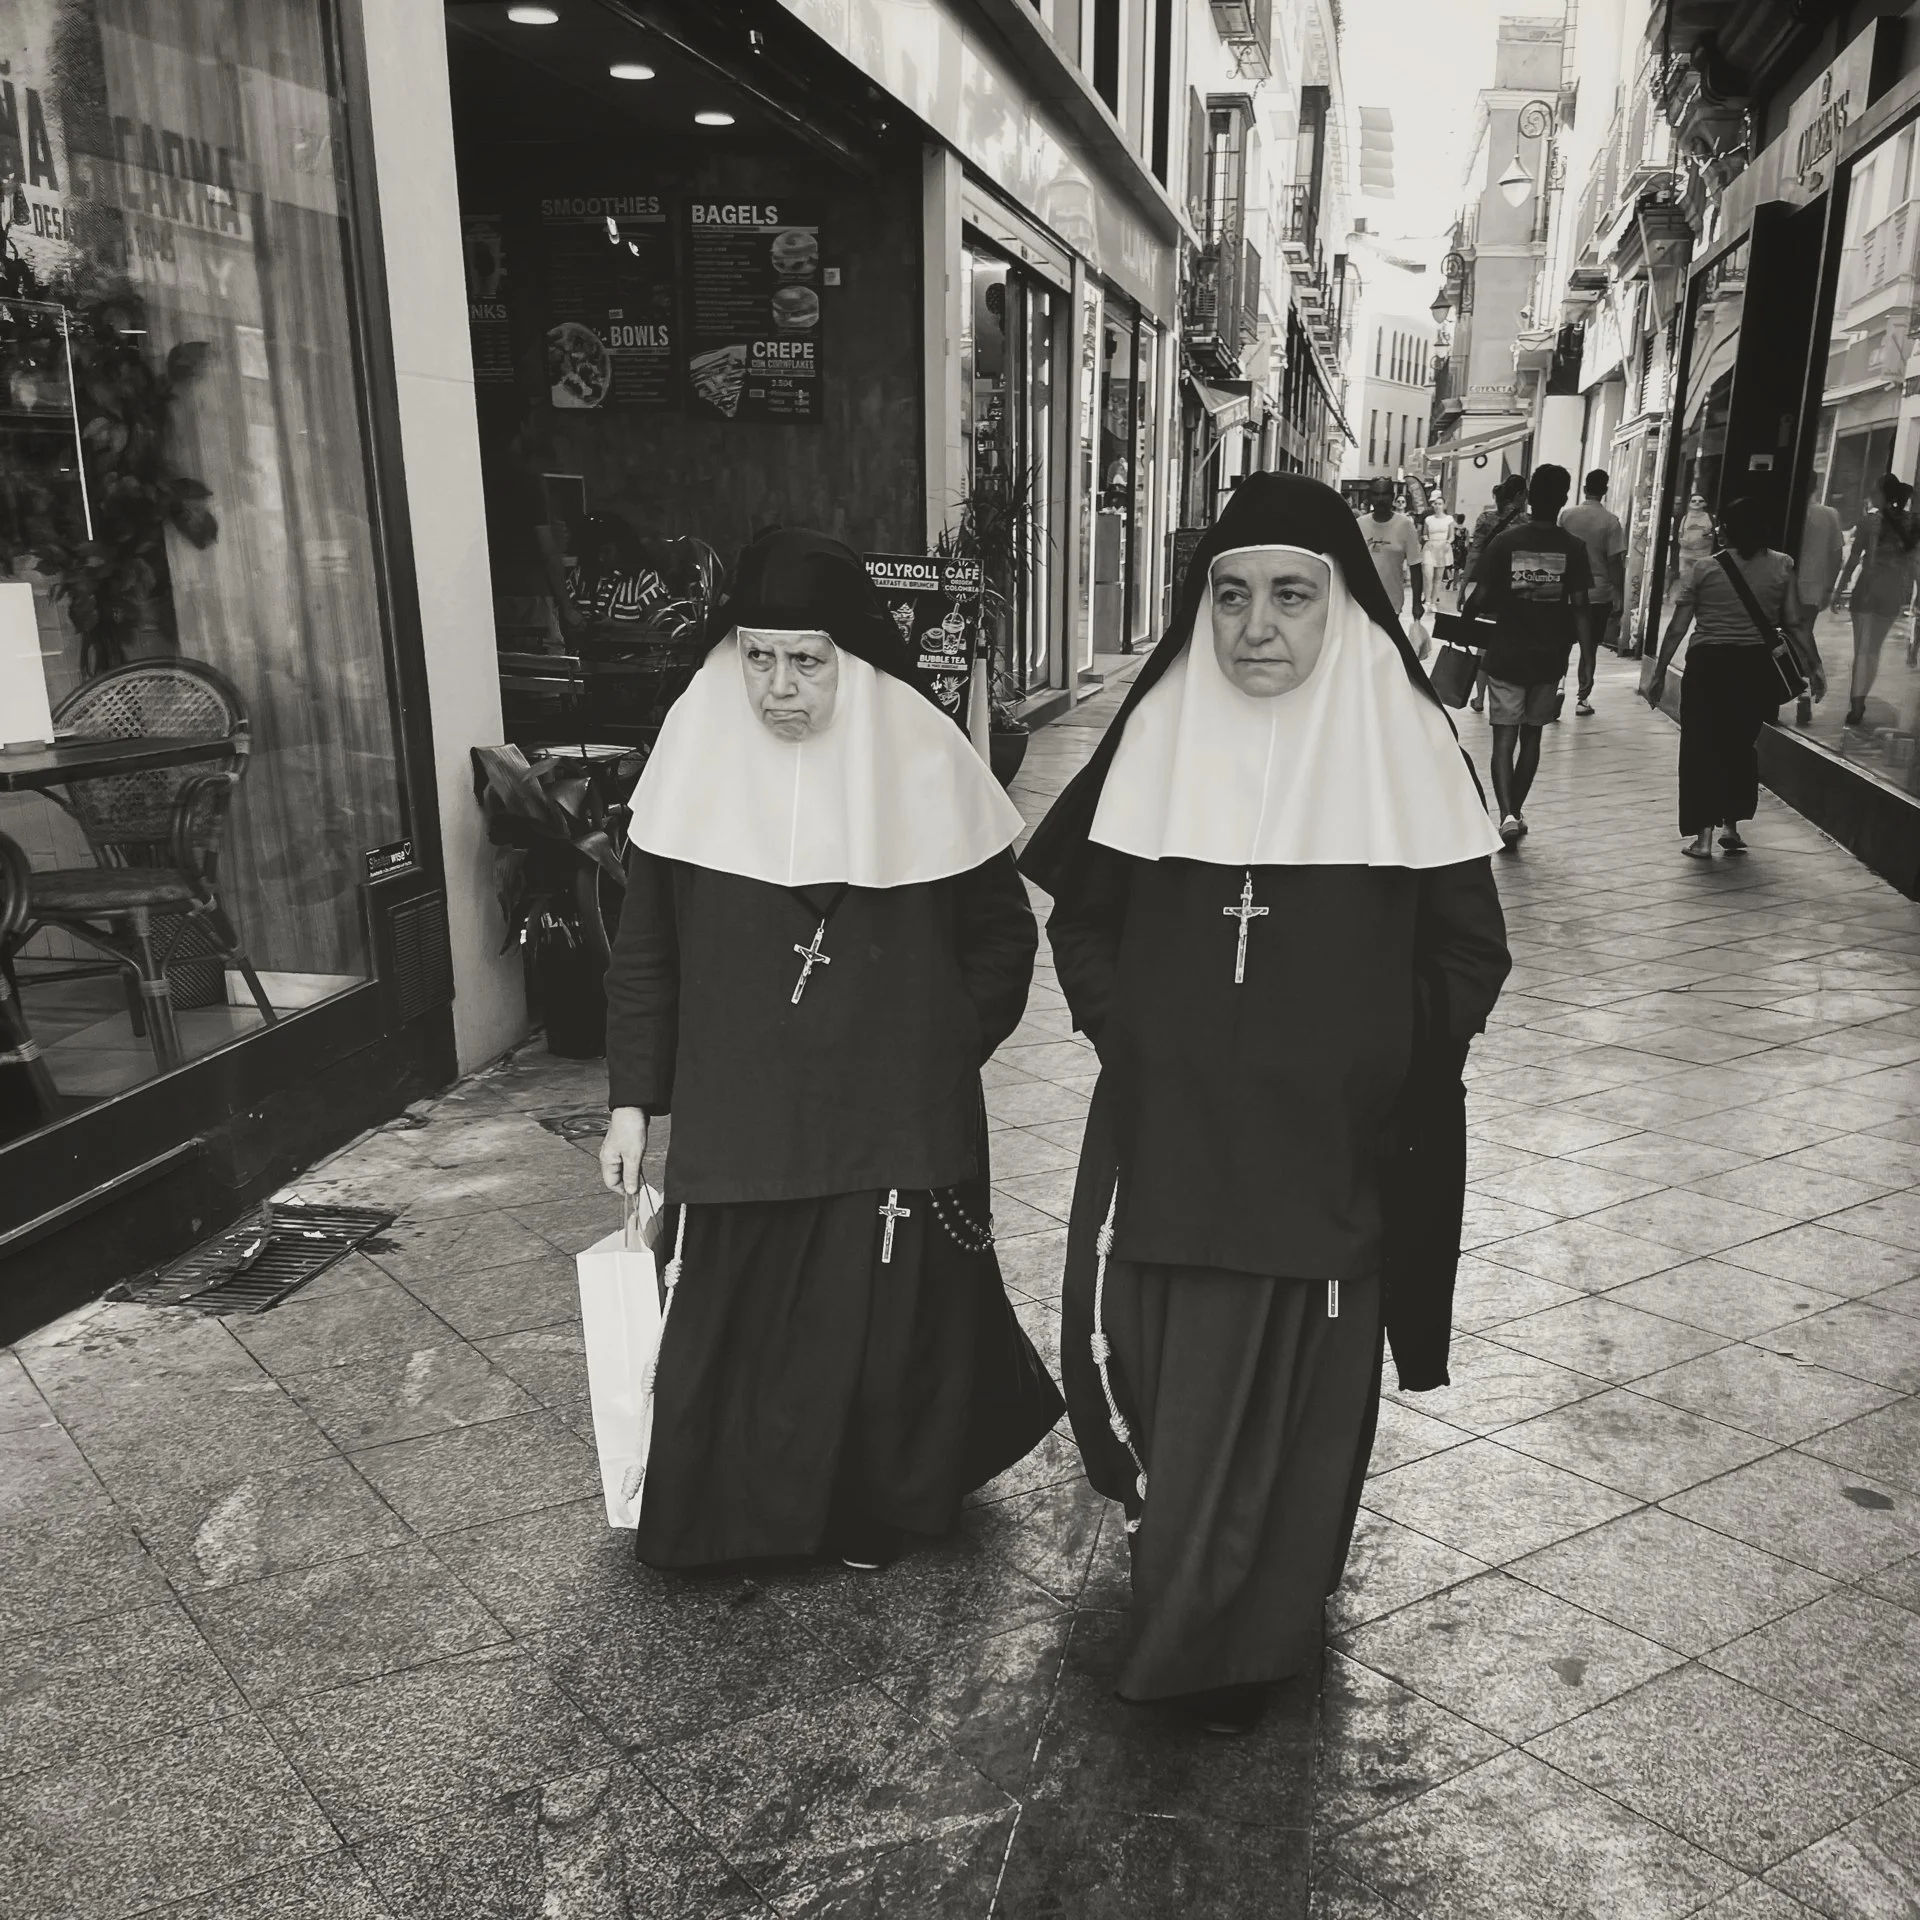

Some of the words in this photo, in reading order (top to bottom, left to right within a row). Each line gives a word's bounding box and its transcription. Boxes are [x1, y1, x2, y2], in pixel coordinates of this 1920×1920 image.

[541, 196, 660, 215] SMOOTHIES
[692, 205, 778, 224] BAGELS
[611, 325, 669, 347] BOWLS
[752, 341, 814, 358] CREPE
[768, 359, 814, 369] CORNFLAKES
[865, 561, 939, 579] HOLYROLL
[1522, 569, 1561, 582] Columbia
[919, 654, 950, 663] BUBBLE
[950, 656, 966, 664] TEA
